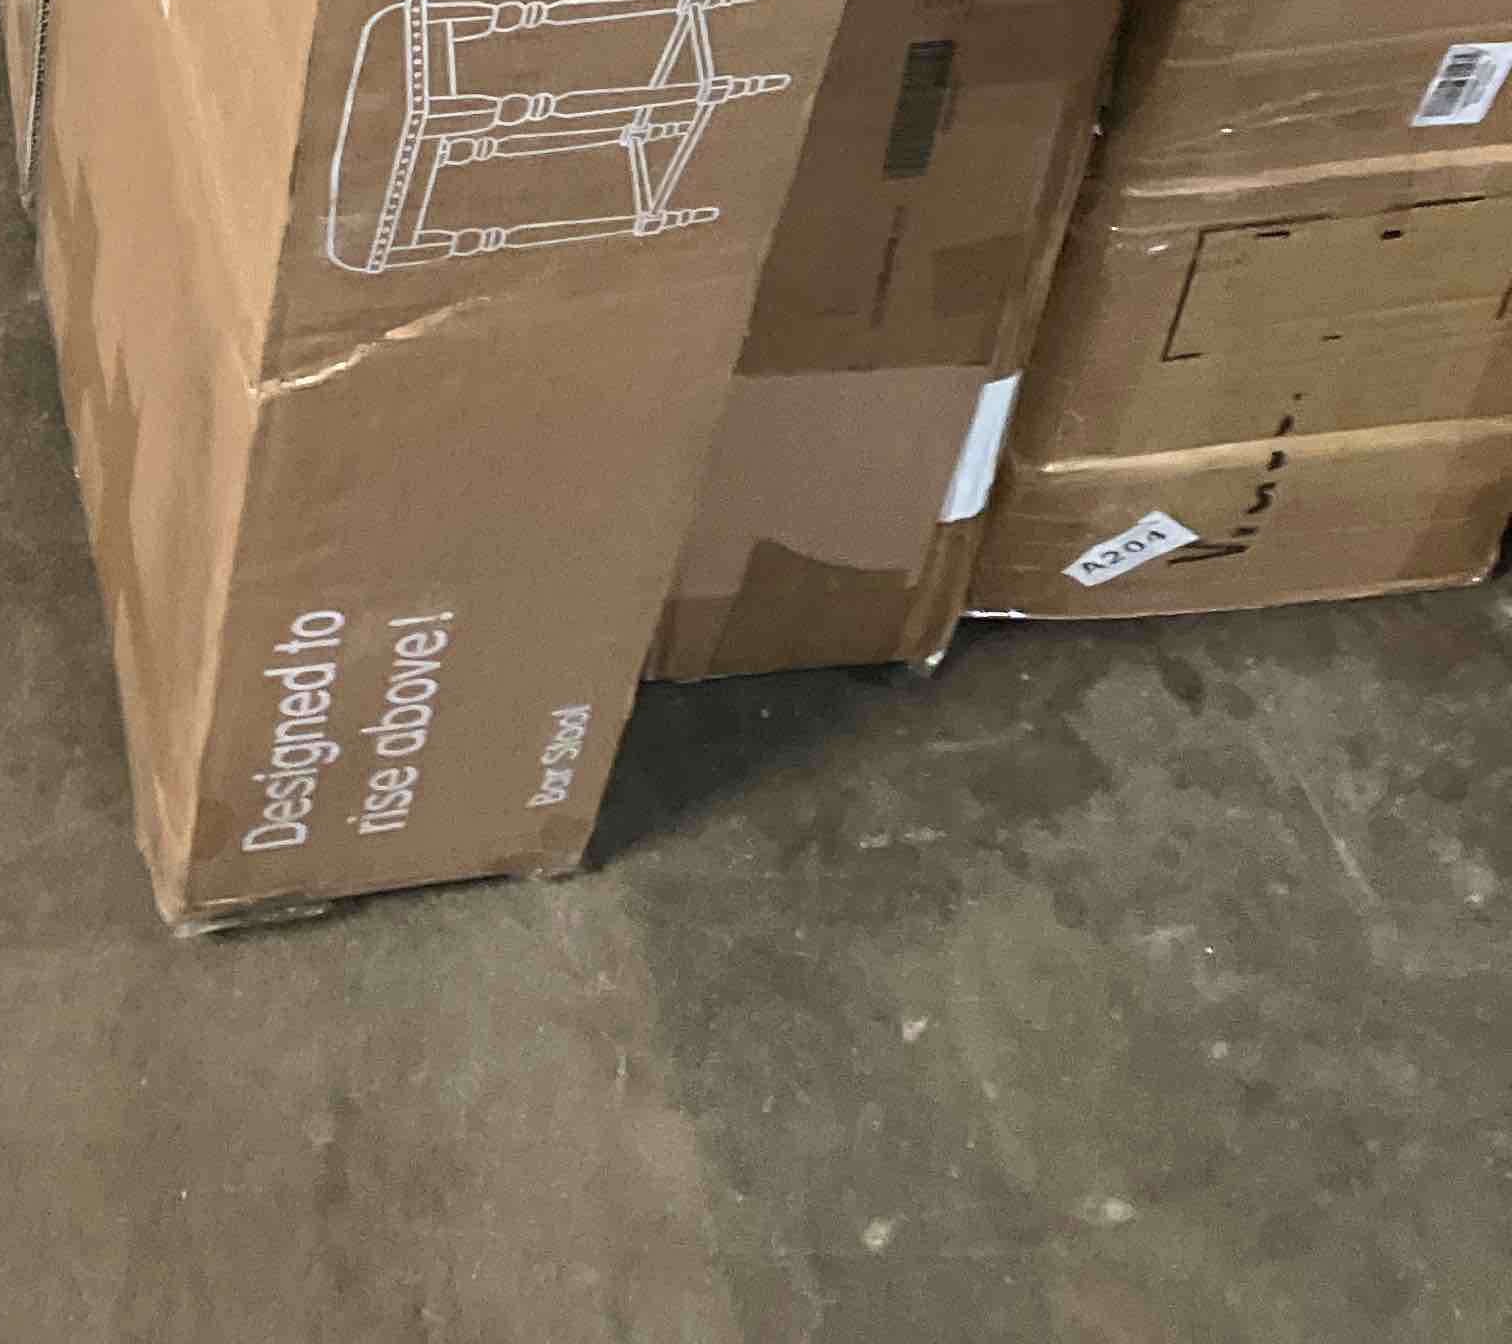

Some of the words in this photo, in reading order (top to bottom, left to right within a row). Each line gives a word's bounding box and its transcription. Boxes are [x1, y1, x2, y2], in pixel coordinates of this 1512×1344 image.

[273, 610, 346, 654] to
[359, 612, 454, 758] above!
[241, 661, 340, 852] Designed
[540, 704, 592, 765] Stool
[346, 766, 419, 835] rise
[525, 768, 574, 807] Bar
